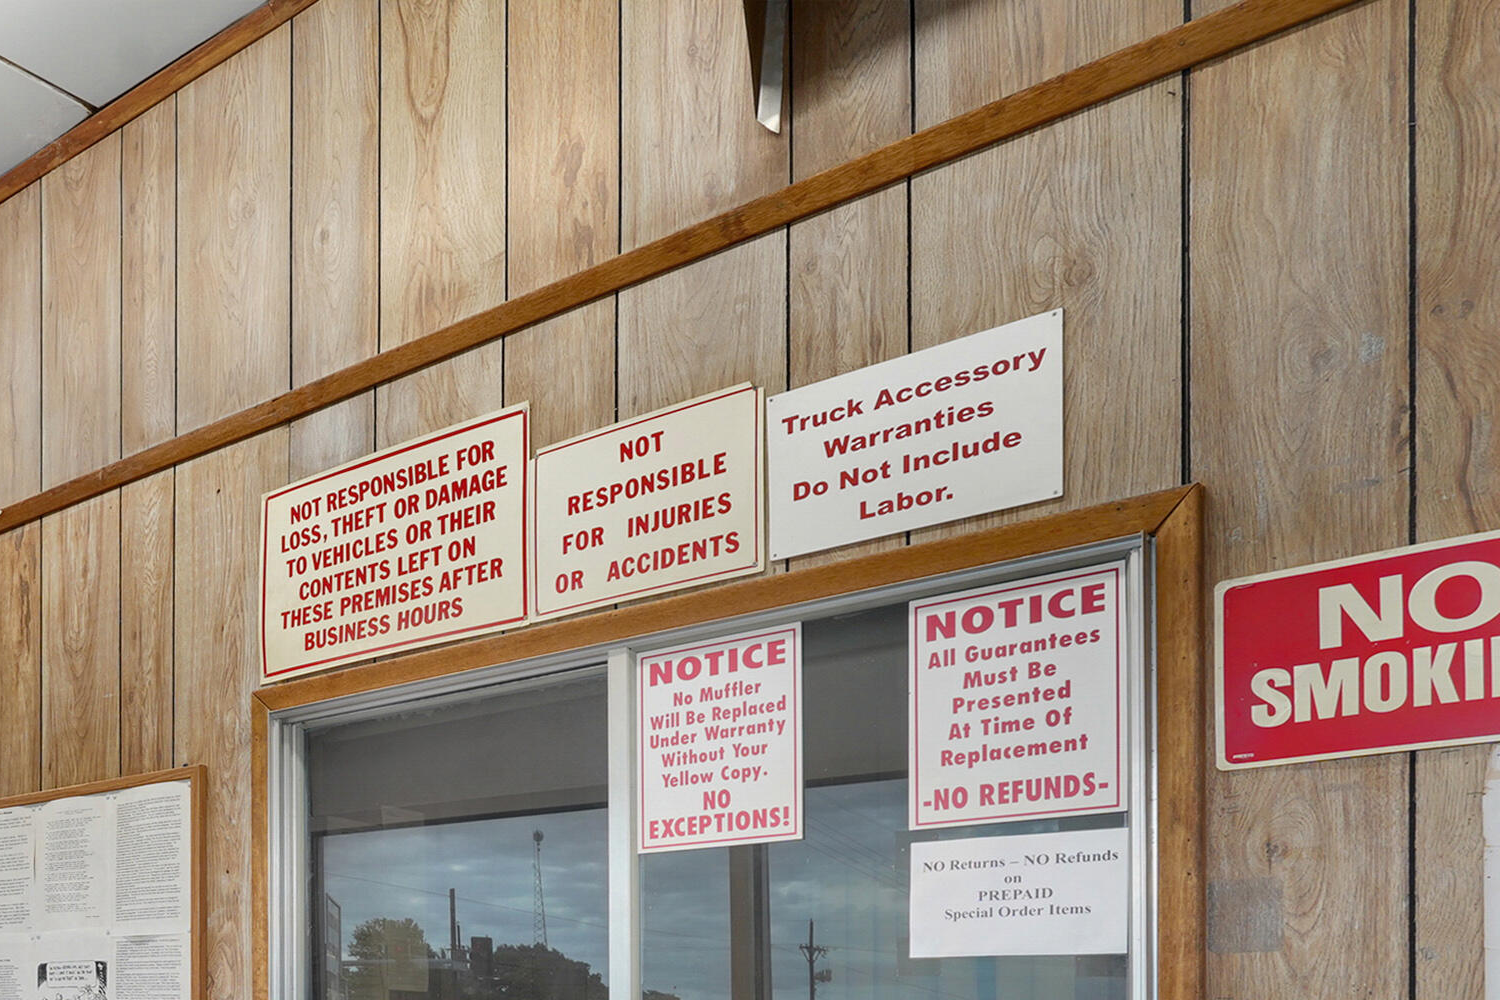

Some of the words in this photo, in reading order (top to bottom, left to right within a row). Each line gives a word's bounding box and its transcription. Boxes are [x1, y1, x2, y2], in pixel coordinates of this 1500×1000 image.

[782, 399, 863, 435] Truck
[874, 347, 1047, 410] Accessory
[619, 431, 664, 463] NOT
[823, 400, 995, 458] Warranties
[290, 497, 322, 525] NOT
[327, 454, 449, 513] RESPONSIBLE
[456, 440, 495, 471] FOR
[568, 452, 727, 516] RESPONSIBLE
[793, 480, 828, 501] Do
[839, 460, 891, 489] Not
[903, 431, 1022, 473] Include
[281, 525, 328, 553] LOSS,
[331, 503, 387, 537] THEFT
[394, 494, 420, 519] OR
[425, 465, 508, 510] DAMAGE
[859, 484, 954, 520] Labor.
[286, 556, 307, 578] TO
[312, 529, 398, 571] VEHICLES
[406, 520, 432, 545] OR
[437, 501, 496, 536] THEIR
[562, 527, 604, 555] FOR
[627, 492, 732, 538] INJURIES
[299, 560, 390, 601] CONTENTS
[398, 546, 443, 577] LEFT
[448, 536, 476, 563] ON
[555, 570, 584, 593] OR
[607, 531, 740, 582] ACCIDENTS
[281, 601, 333, 630] THESE
[340, 576, 433, 617] PREMISES
[439, 557, 503, 593] AFTER
[926, 582, 1106, 642] NOTICE
[1318, 561, 1500, 650] NO
[304, 615, 391, 651] BUSINESS
[397, 597, 463, 631] HOURS
[649, 639, 786, 687] NOTICE
[928, 648, 956, 669] All
[965, 629, 1101, 663] Guarantees
[673, 692, 693, 707] No
[700, 680, 761, 703] Muffler
[963, 666, 1018, 689] Must
[1028, 661, 1057, 679] Be
[1250, 636, 1500, 728] SMOKI
[650, 712, 680, 730] Will
[686, 711, 706, 725] Be
[711, 694, 787, 723] Replaced
[953, 679, 1072, 714] Presented
[650, 730, 697, 749] Under
[705, 718, 786, 741] Warranty
[948, 722, 971, 741] At
[981, 716, 1035, 736] Time
[1045, 706, 1073, 727] Of
[661, 746, 725, 767] Without
[732, 742, 768, 758] Your
[941, 734, 1089, 768] Replacement
[662, 770, 713, 788] Yellow
[721, 765, 768, 783] Copy.
[703, 789, 731, 811] NO
[649, 806, 789, 839] EXCEPTIONS!
[923, 861, 945, 872] NO
[950, 857, 1006, 871] Returns
[1024, 853, 1049, 866] NO
[1055, 849, 1119, 864] Refunds
[1004, 874, 1022, 884] on
[944, 908, 993, 922] Special
[998, 906, 1044, 918] Order
[1049, 904, 1092, 915] Items
[978, 887, 1053, 902] PREPAID
